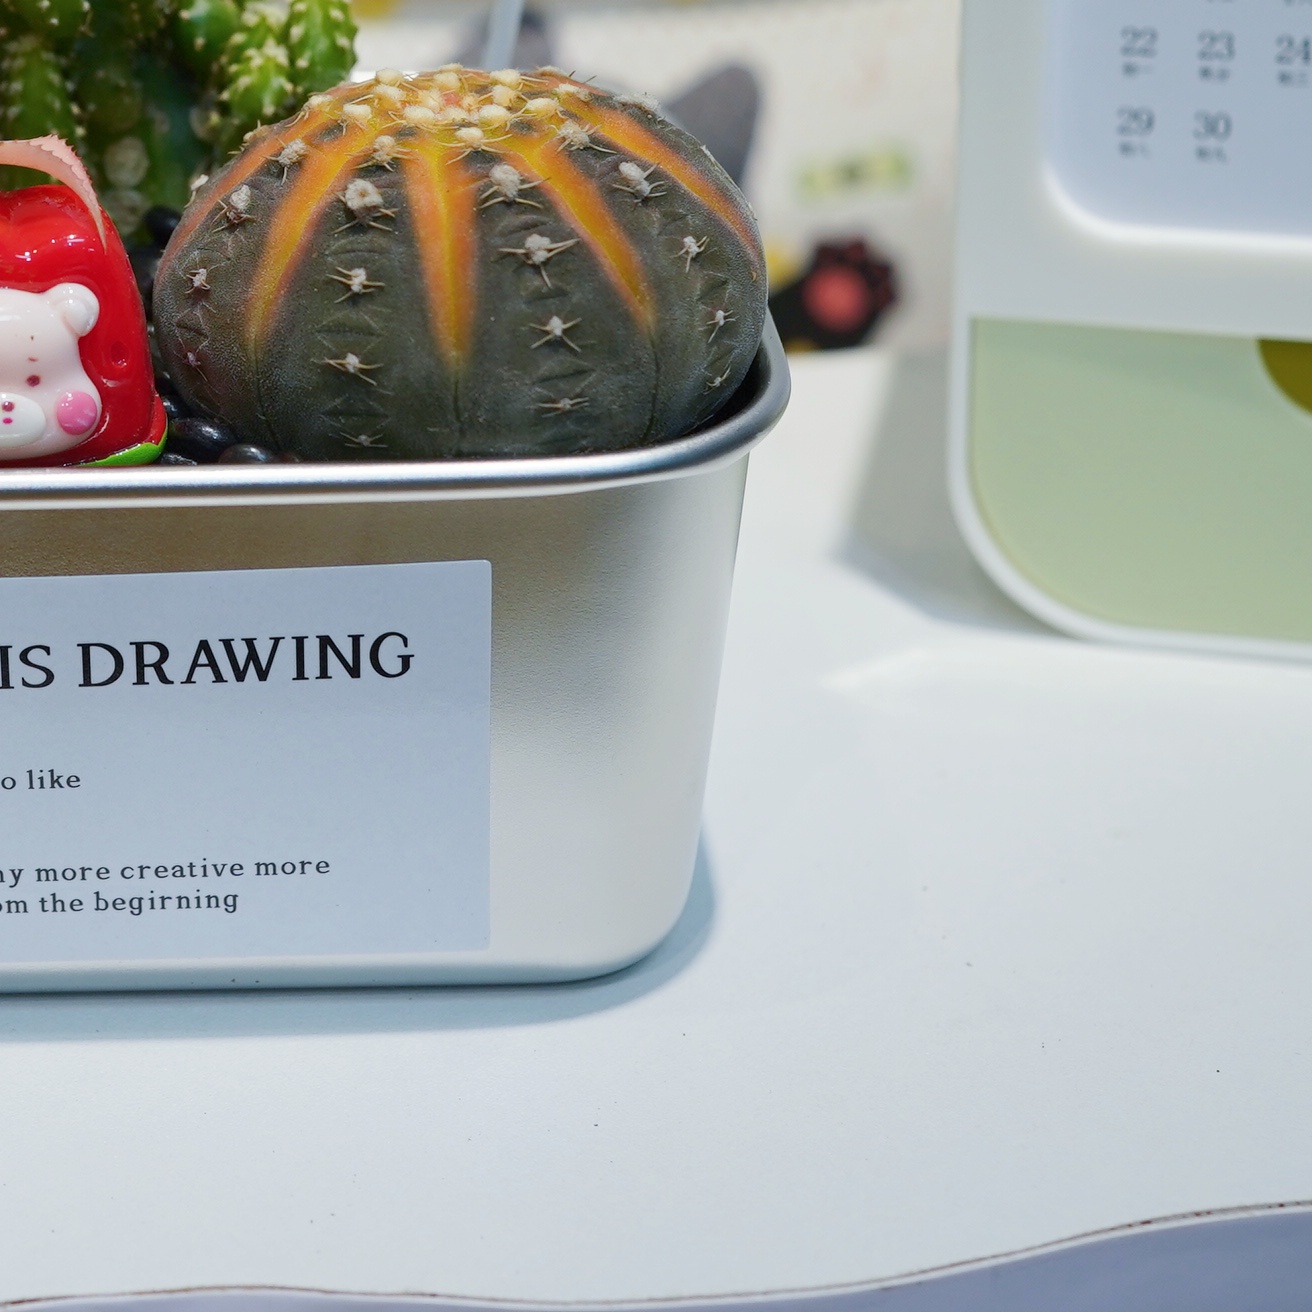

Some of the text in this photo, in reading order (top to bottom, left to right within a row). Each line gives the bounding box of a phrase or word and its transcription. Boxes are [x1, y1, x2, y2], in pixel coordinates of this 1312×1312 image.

[1120, 27, 1159, 58] 22
[1198, 31, 1236, 61] 23
[1116, 107, 1233, 141] 29 30
[76, 631, 415, 688] DRAWING
[26, 768, 81, 790] like
[34, 866, 111, 883] more
[120, 861, 245, 880] creative
[254, 860, 330, 876] more
[38, 892, 84, 913] the
